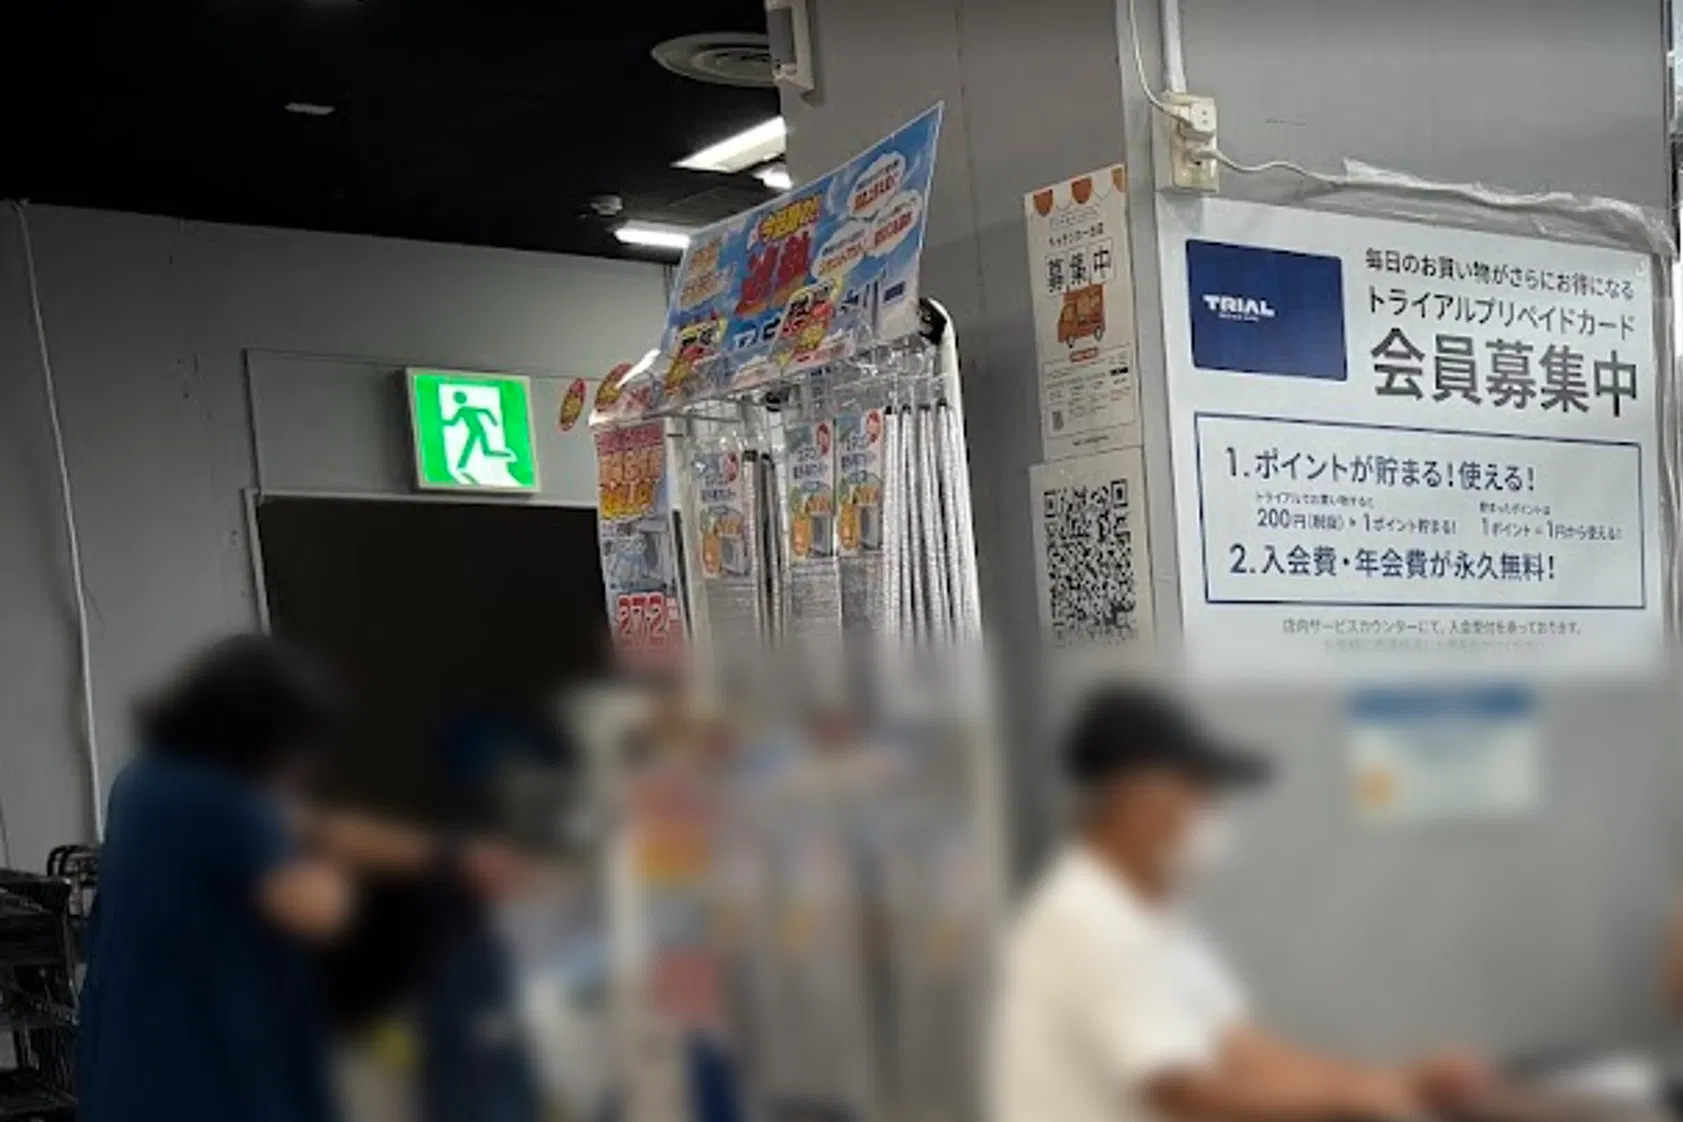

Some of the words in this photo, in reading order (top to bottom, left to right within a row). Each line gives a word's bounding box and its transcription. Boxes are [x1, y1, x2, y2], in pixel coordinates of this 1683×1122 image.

[1365, 247, 1636, 301] 毎日のお買い物がさらにお得になる
[1202, 293, 1276, 318] TRIAL
[1368, 285, 1636, 341] トライアルプリペイドカード
[1370, 327, 1639, 418] 会員募集中
[1229, 542, 1556, 582] 2.入会費・年会費が永久無料!
